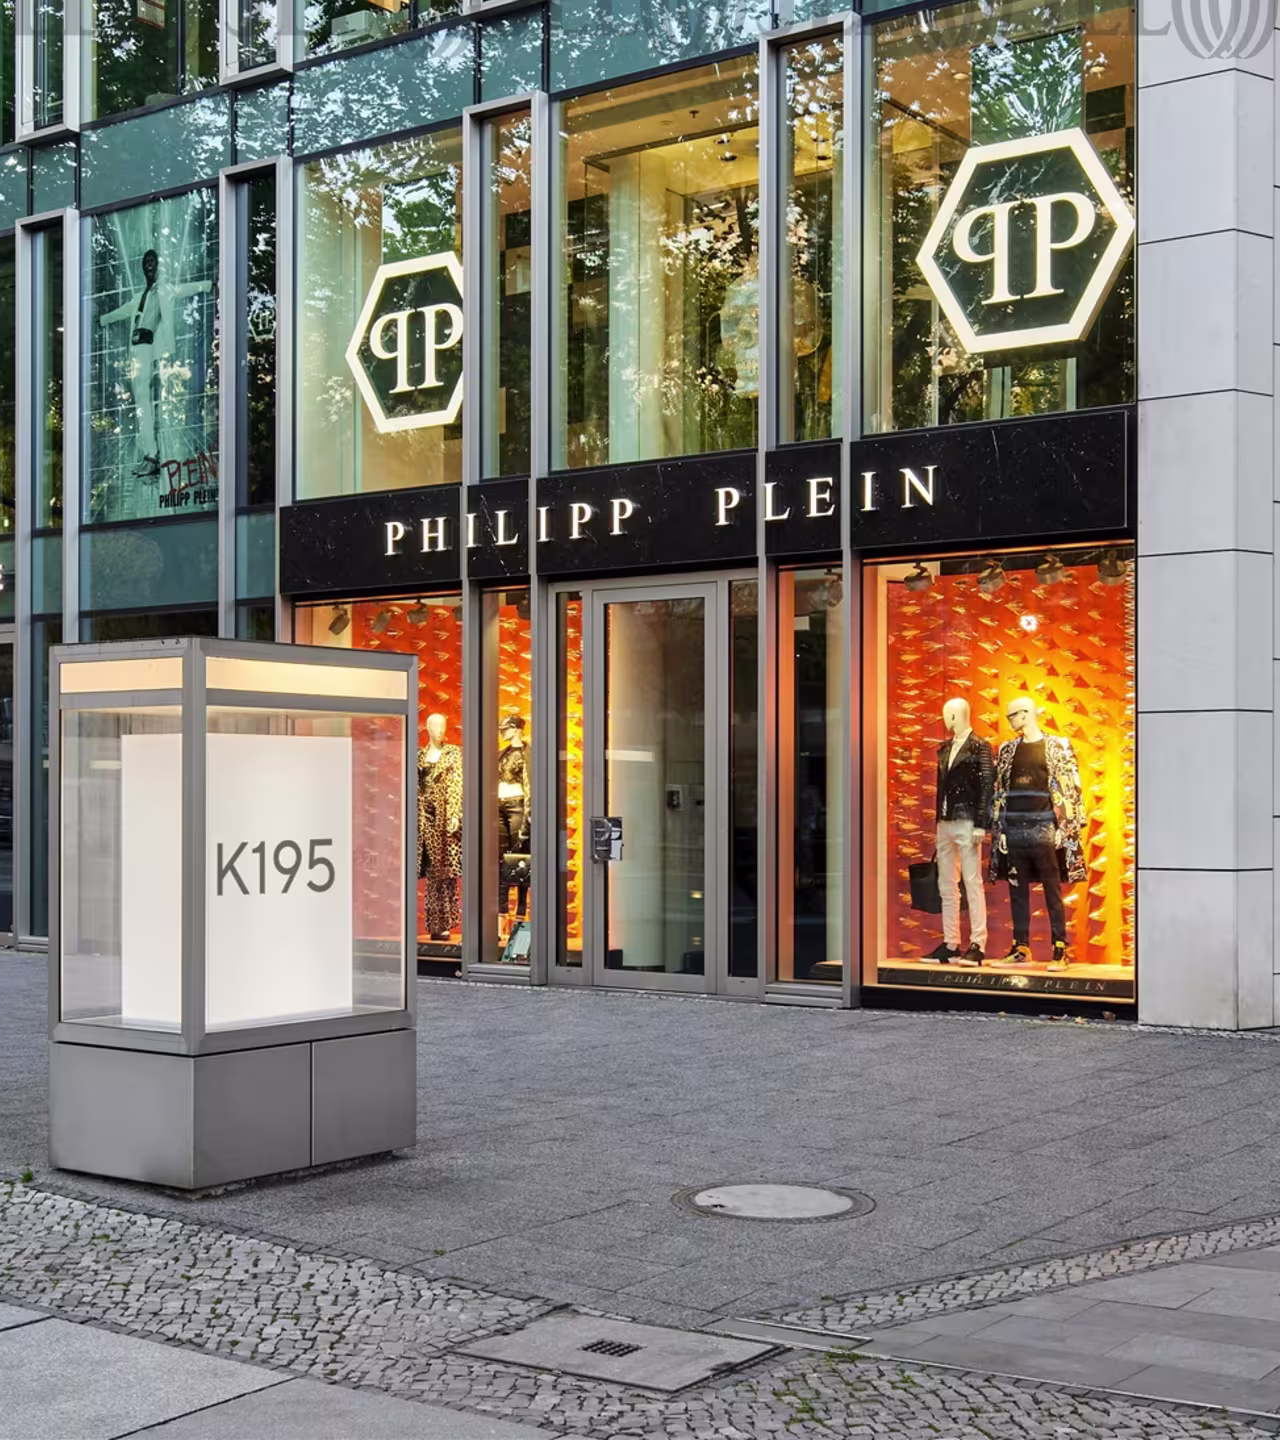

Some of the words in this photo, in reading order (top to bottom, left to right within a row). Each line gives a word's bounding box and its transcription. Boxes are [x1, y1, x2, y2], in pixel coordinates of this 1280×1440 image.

[160, 492, 190, 508] PHILIPP
[384, 498, 633, 556] PHILIPP
[714, 465, 939, 526] PLEIN
[216, 838, 336, 896] K195
